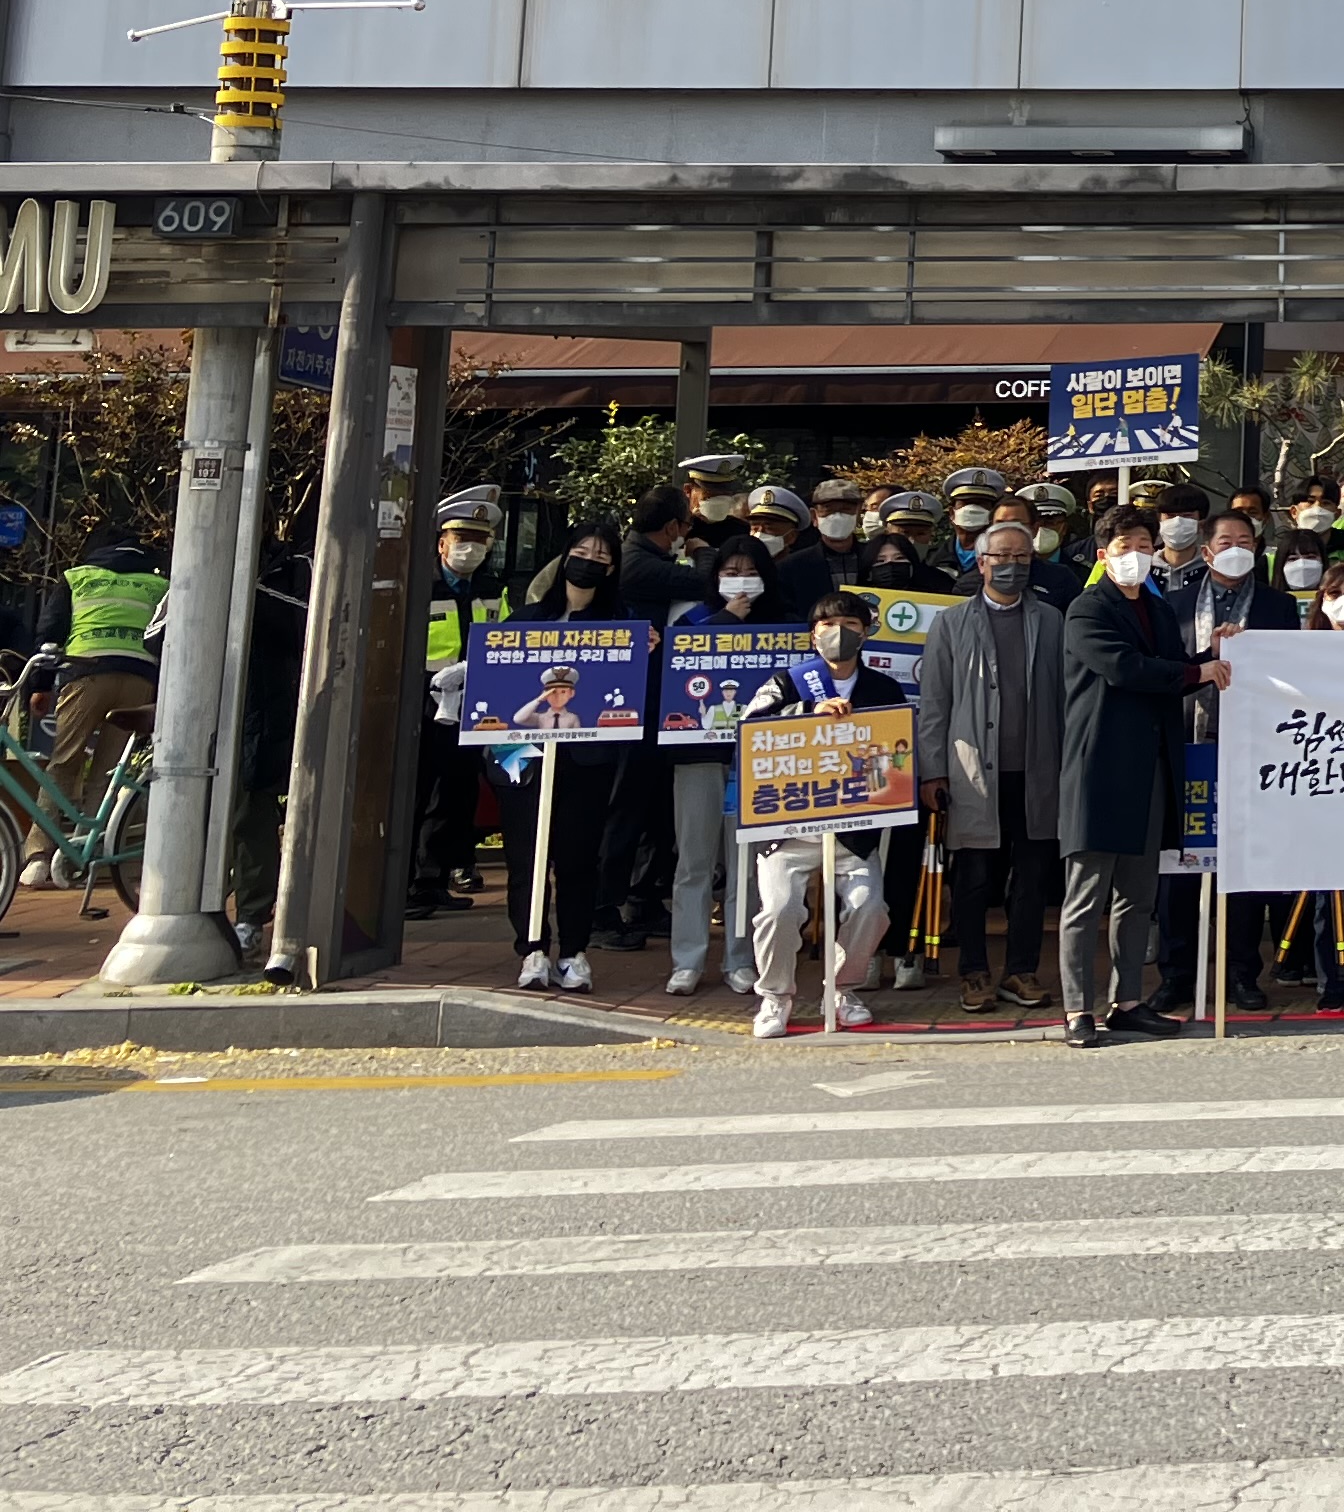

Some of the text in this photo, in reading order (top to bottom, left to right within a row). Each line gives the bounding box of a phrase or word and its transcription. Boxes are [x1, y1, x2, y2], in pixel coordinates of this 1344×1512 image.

[157, 200, 231, 232] 609
[1066, 364, 1182, 393] 사람이 보이면
[1071, 386, 1181, 420] 일단 멈춤!
[485, 629, 635, 649] 우리 곁에 자치경찰,
[673, 634, 711, 653] 우리
[714, 633, 752, 652] 곁에
[486, 648, 632, 664] 안전한 교통문화 우리 곁에
[730, 654, 773, 669] 안전한
[751, 722, 871, 753] 차보다 사람이
[752, 751, 848, 779] 먼저인 곳,
[752, 777, 870, 815] 충청남도
